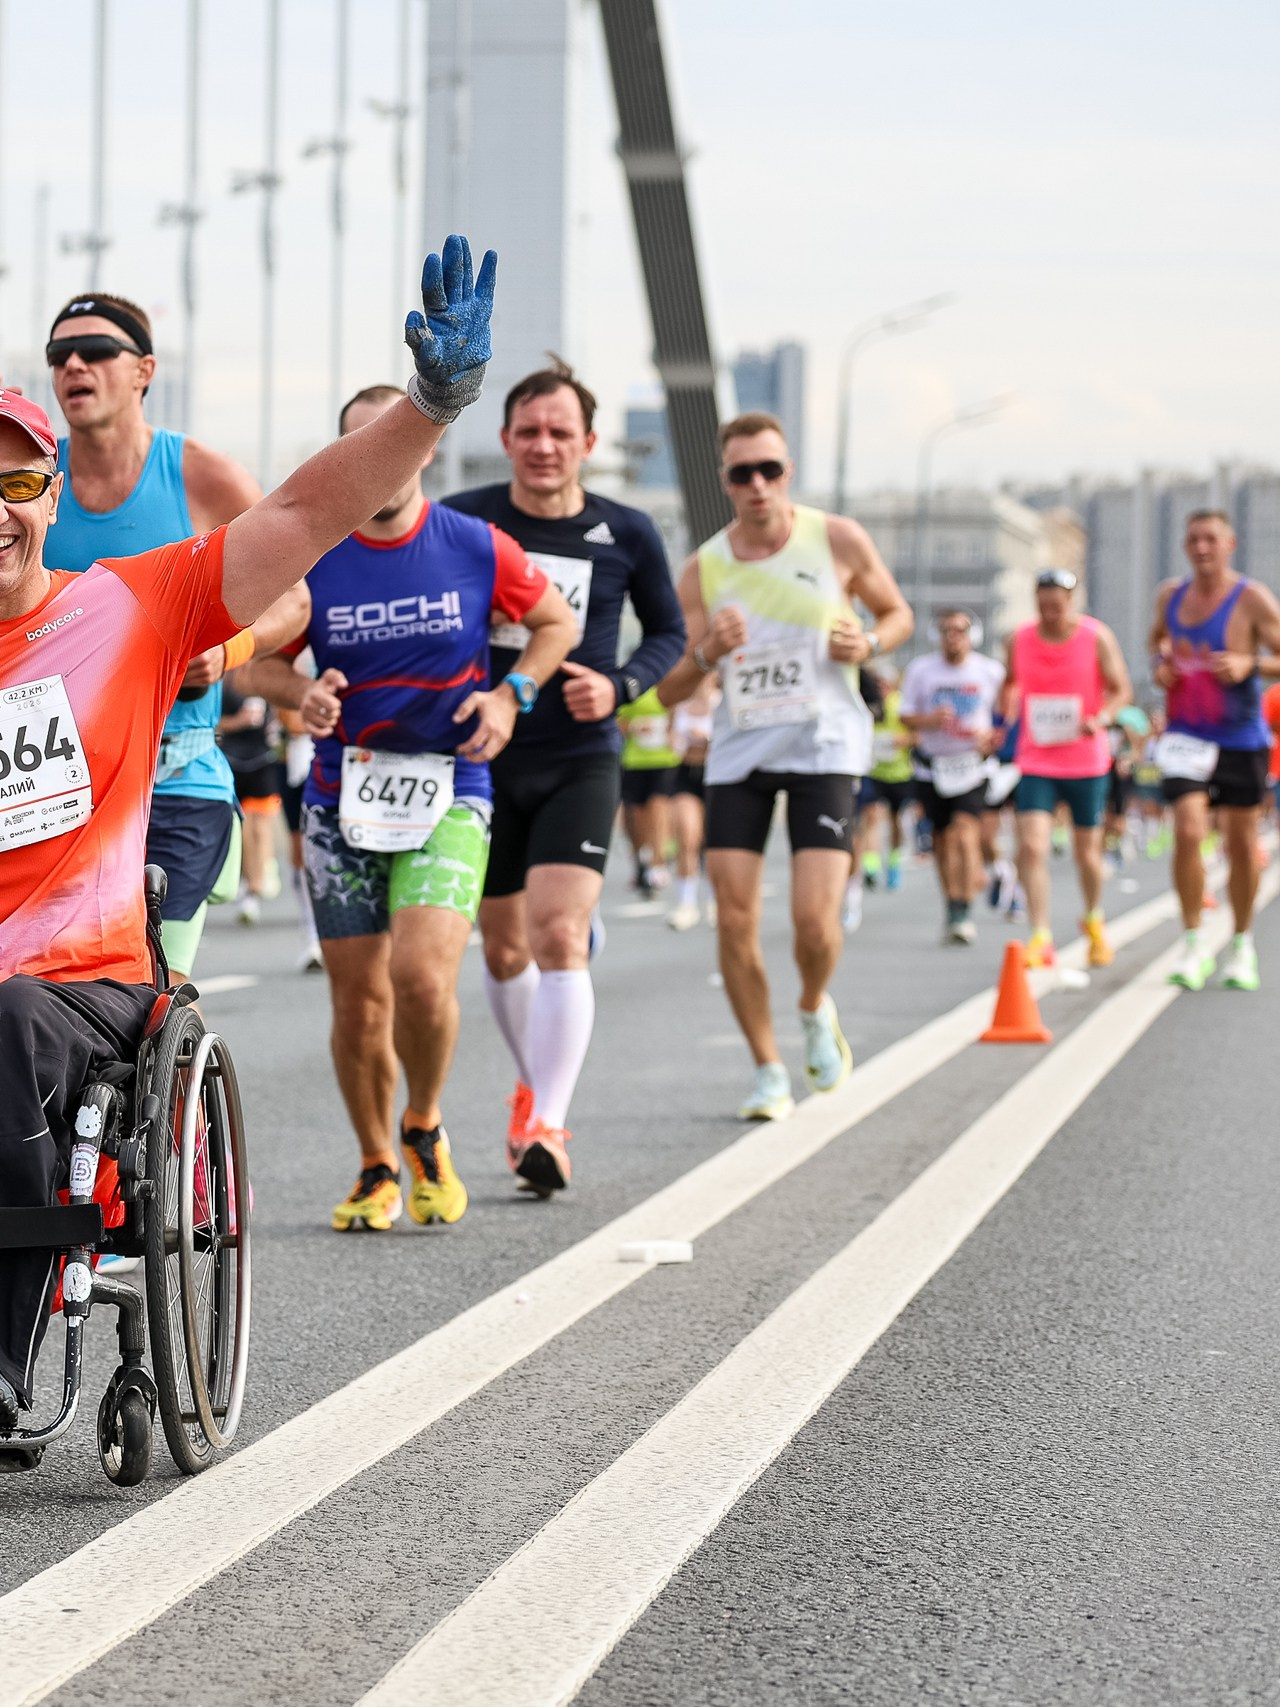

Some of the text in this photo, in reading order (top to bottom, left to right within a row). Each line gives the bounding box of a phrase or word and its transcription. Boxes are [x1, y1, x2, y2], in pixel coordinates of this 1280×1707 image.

[26, 606, 85, 642] bodycore
[326, 590, 461, 632] SOCHI
[326, 615, 465, 646] AUTODROM
[29, 685, 43, 697] КМ
[736, 660, 803, 694] 2762
[70, 770, 78, 778] 2
[357, 774, 438, 807] 6479
[348, 824, 364, 842] G
